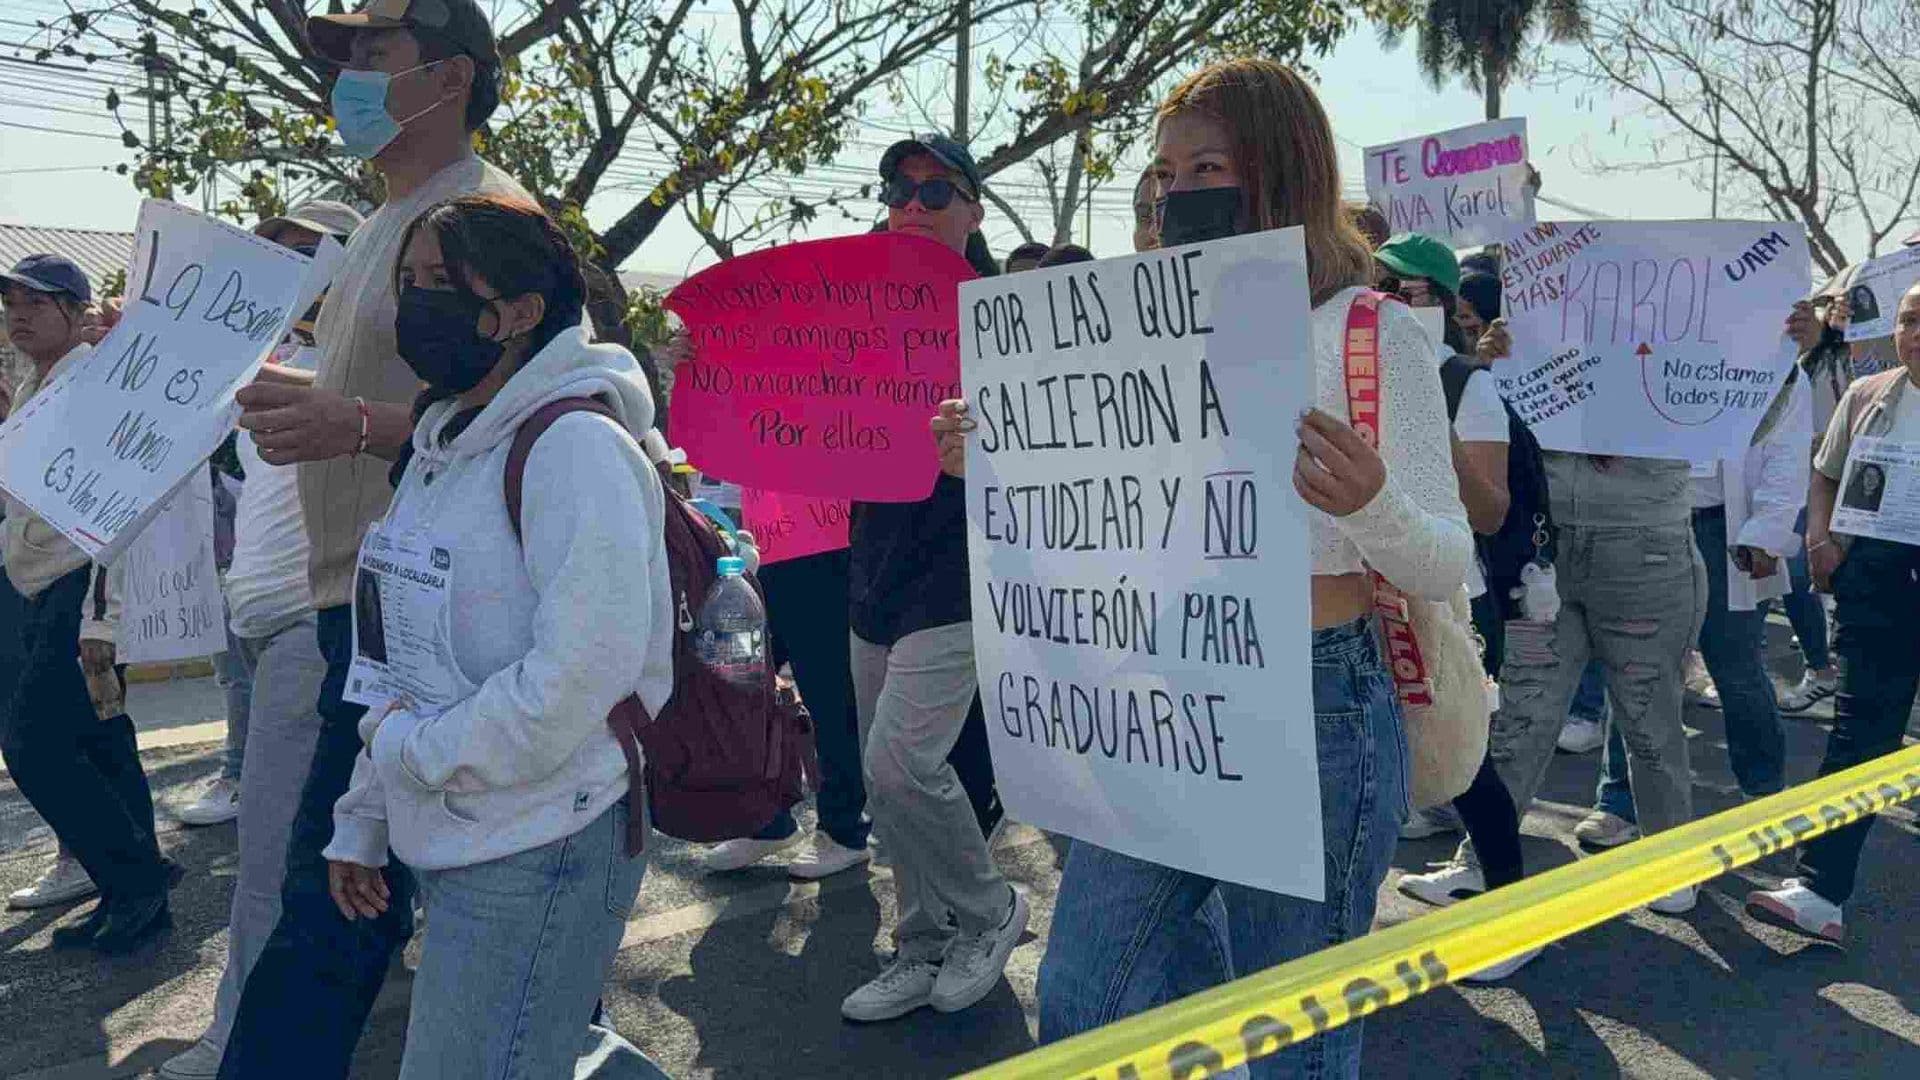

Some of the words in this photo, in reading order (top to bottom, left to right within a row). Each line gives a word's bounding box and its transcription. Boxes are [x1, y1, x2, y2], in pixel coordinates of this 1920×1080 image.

[1371, 149, 1411, 187] TE
[1443, 174, 1507, 235] Karol
[1724, 230, 1790, 282] UAEM
[884, 281, 938, 313] con
[974, 292, 1033, 359] POR
[1048, 271, 1112, 350] LAS
[1133, 250, 1214, 339] QUE
[1561, 255, 1718, 345] KAROL
[105, 333, 158, 391] No
[164, 367, 204, 405] es
[903, 327, 959, 370] par
[1663, 358, 1692, 379] No
[752, 409, 808, 446] Por
[823, 409, 890, 450] ellas
[979, 364, 1181, 453] SALIERON
[1200, 359, 1230, 439] A
[984, 475, 1144, 551] ESTUDIAR
[1160, 476, 1181, 549] Y
[1204, 479, 1257, 554] NO
[988, 575, 1158, 656] VOLVIERÓN
[1181, 592, 1265, 669] PARA
[999, 672, 1243, 781] GRADUARSE
